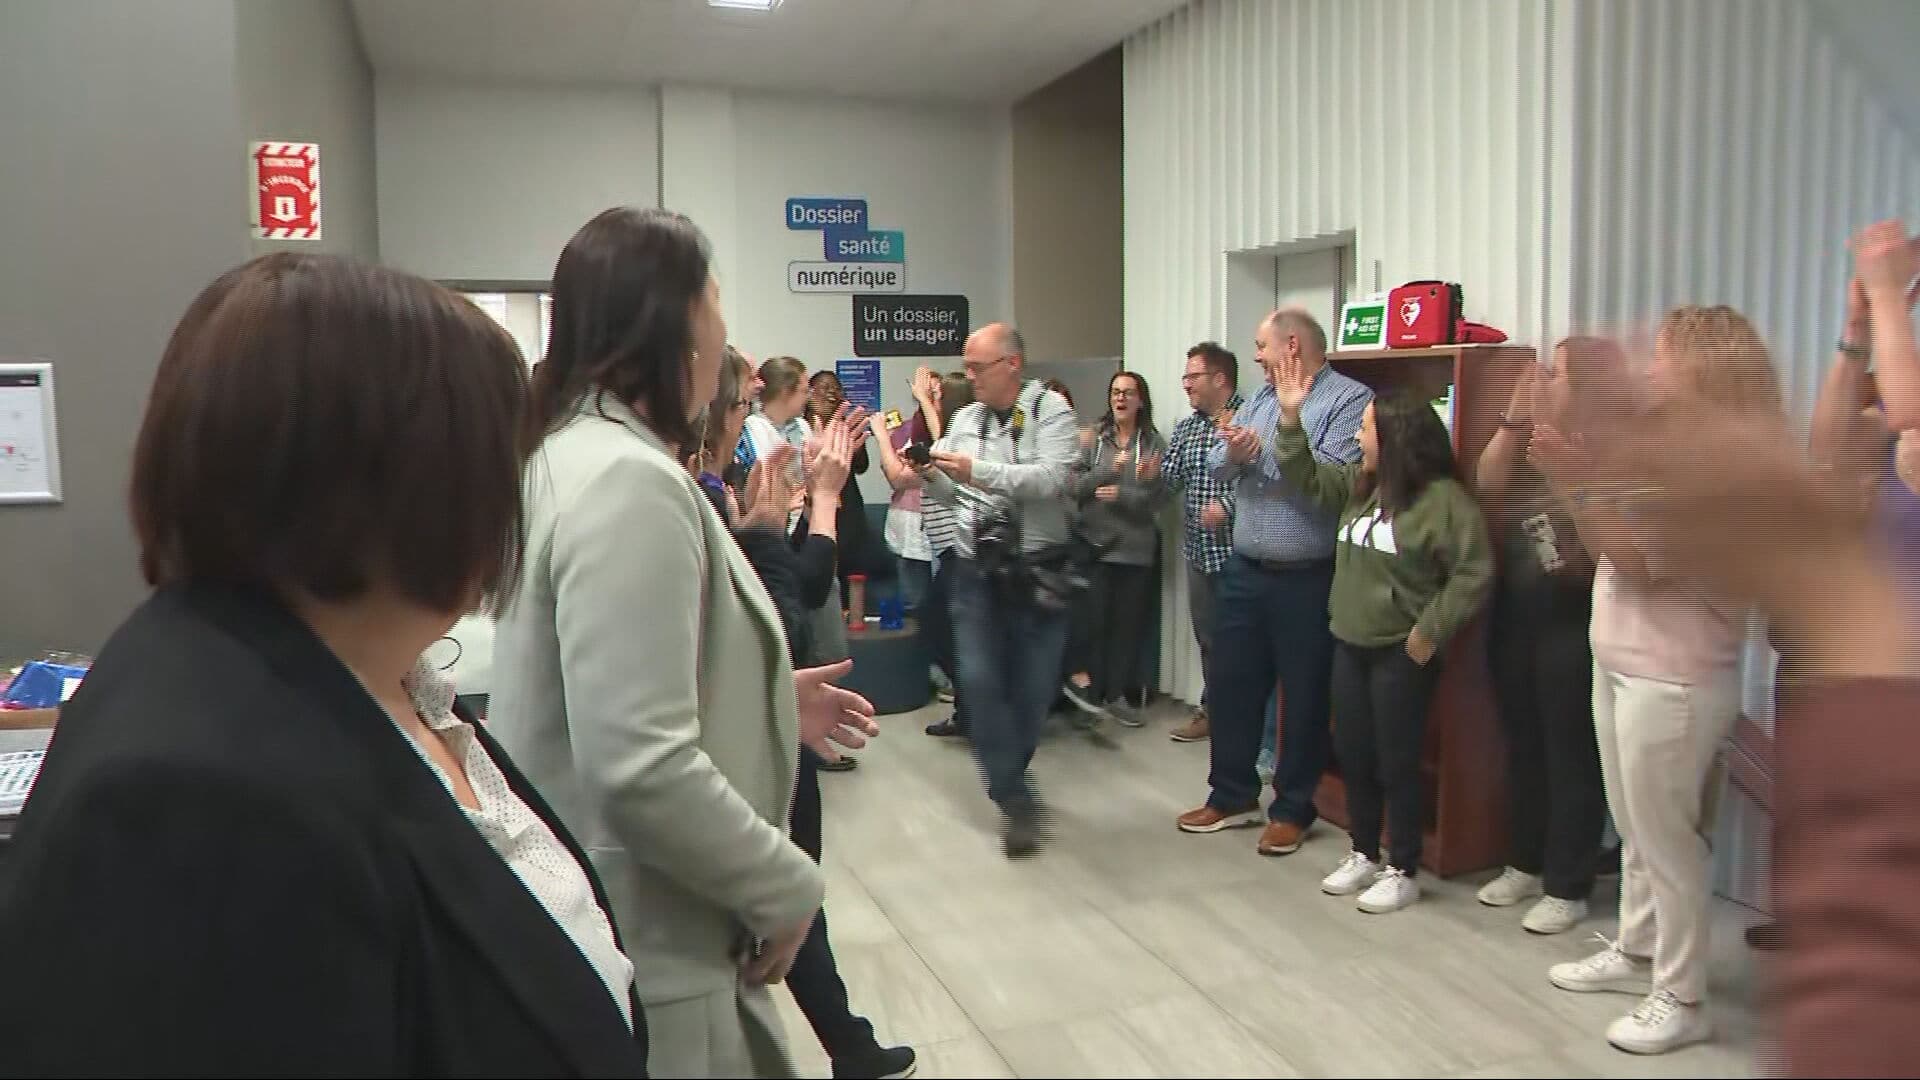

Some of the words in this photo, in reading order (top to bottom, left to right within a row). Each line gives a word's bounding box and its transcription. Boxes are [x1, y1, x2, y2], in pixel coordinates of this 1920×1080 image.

[791, 204, 862, 224] Dossier
[838, 235, 890, 255] santé
[797, 265, 897, 289] numérique
[863, 305, 889, 323] Un
[893, 305, 959, 325] dossier,
[863, 328, 888, 342] un
[893, 328, 960, 345] usager.
